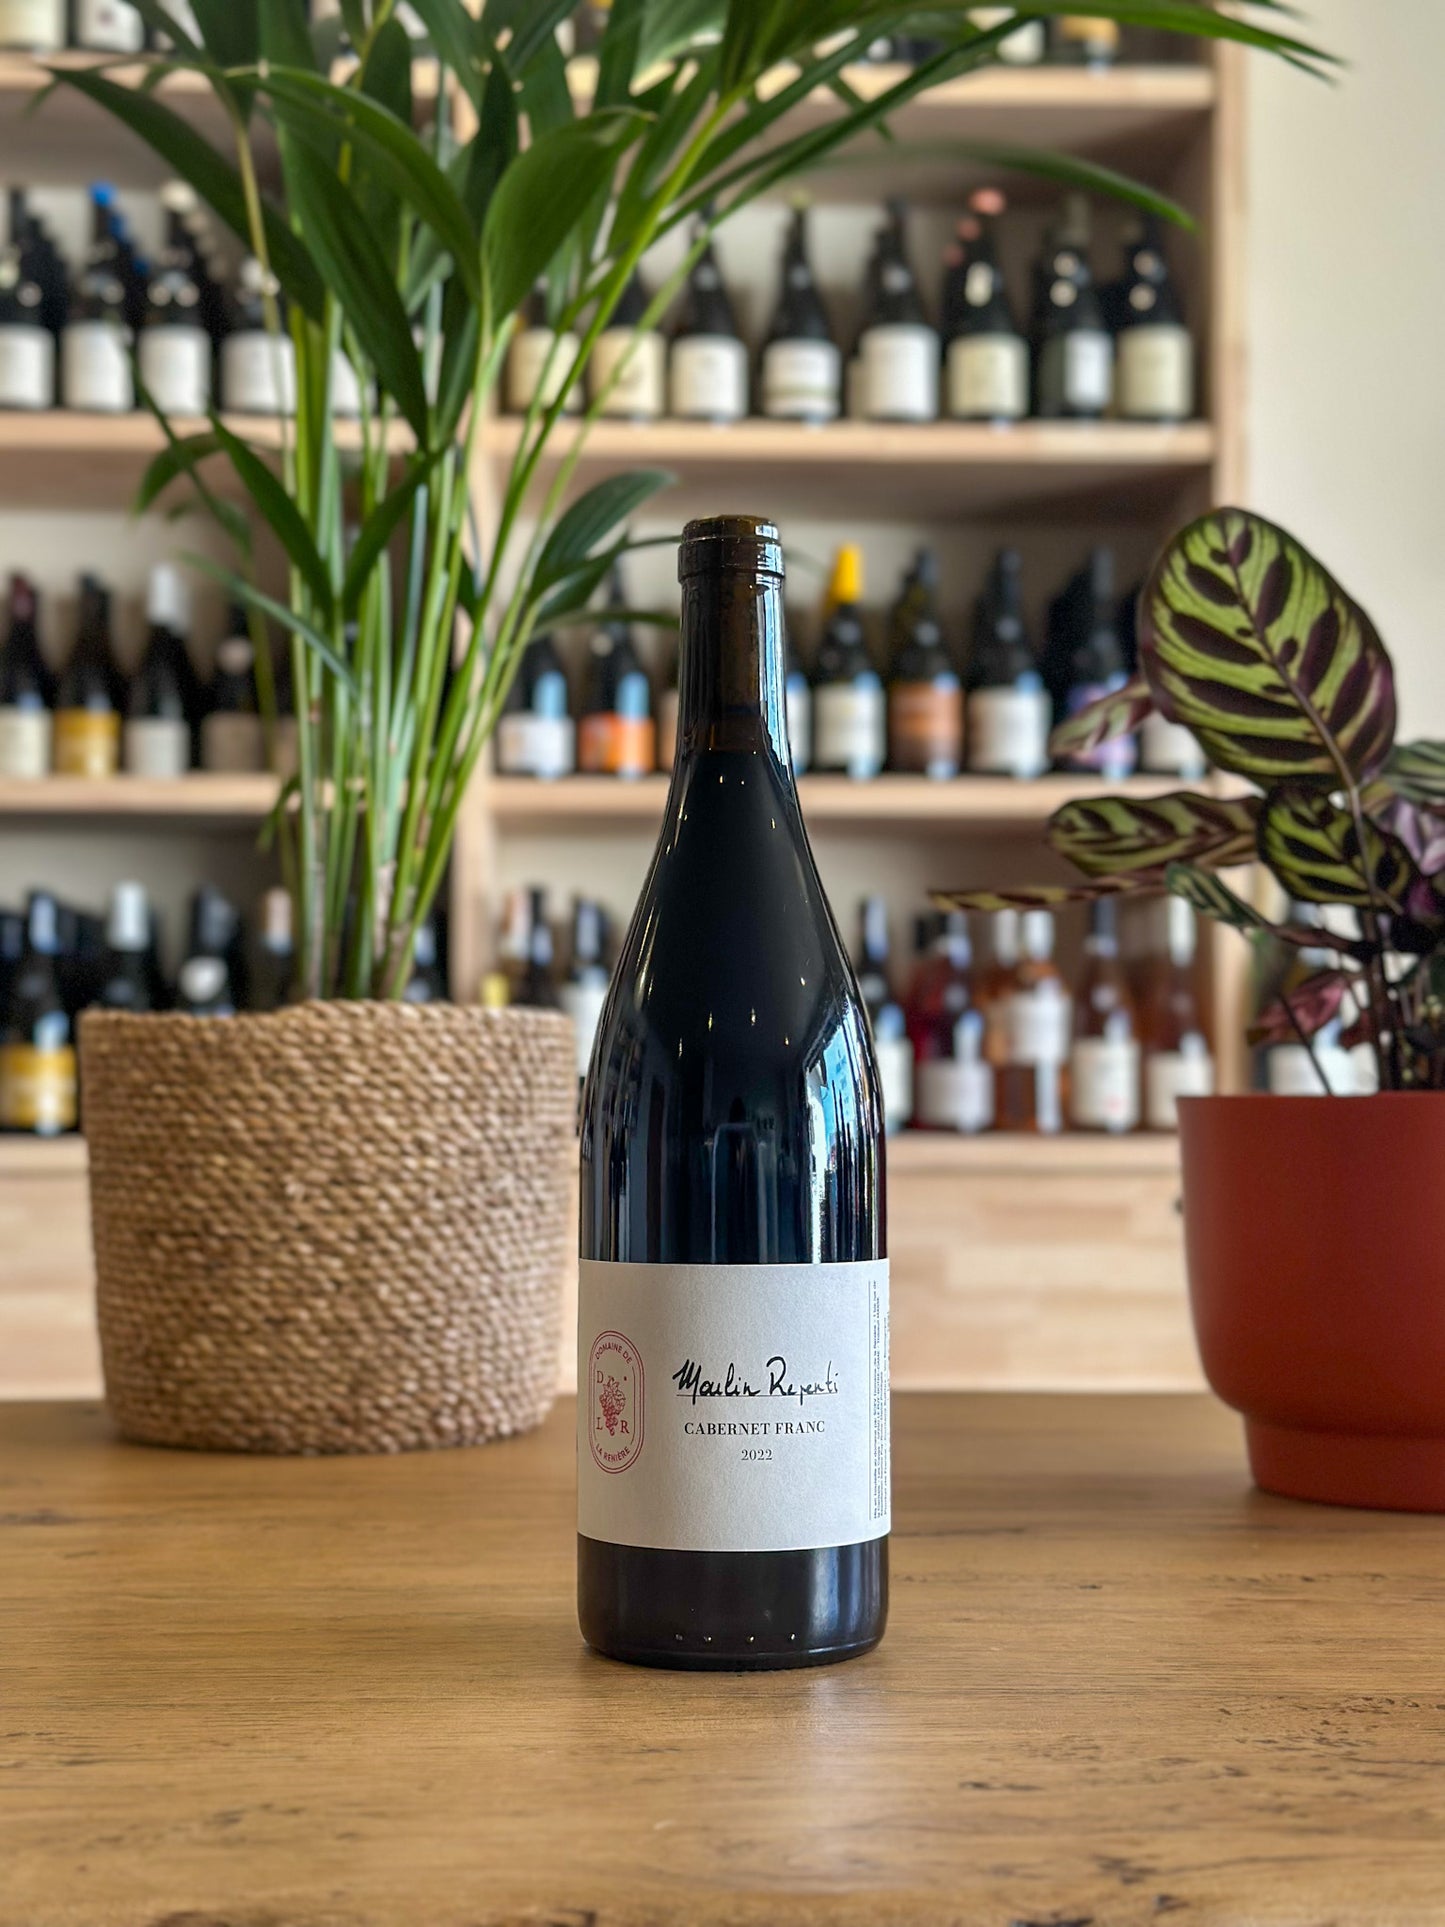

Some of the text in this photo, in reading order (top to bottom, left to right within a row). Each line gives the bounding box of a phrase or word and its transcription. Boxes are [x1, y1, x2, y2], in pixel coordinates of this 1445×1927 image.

[595, 1342, 633, 1365] DOMAINE DE
[596, 1370, 604, 1384] D
[672, 1356, 839, 1405] Moulin Repenti
[596, 1417, 630, 1434] L R
[684, 1421, 826, 1436] CABERNET FRANC
[595, 1443, 631, 1462] LA RENIÈRE
[741, 1449, 773, 1461] 2022
